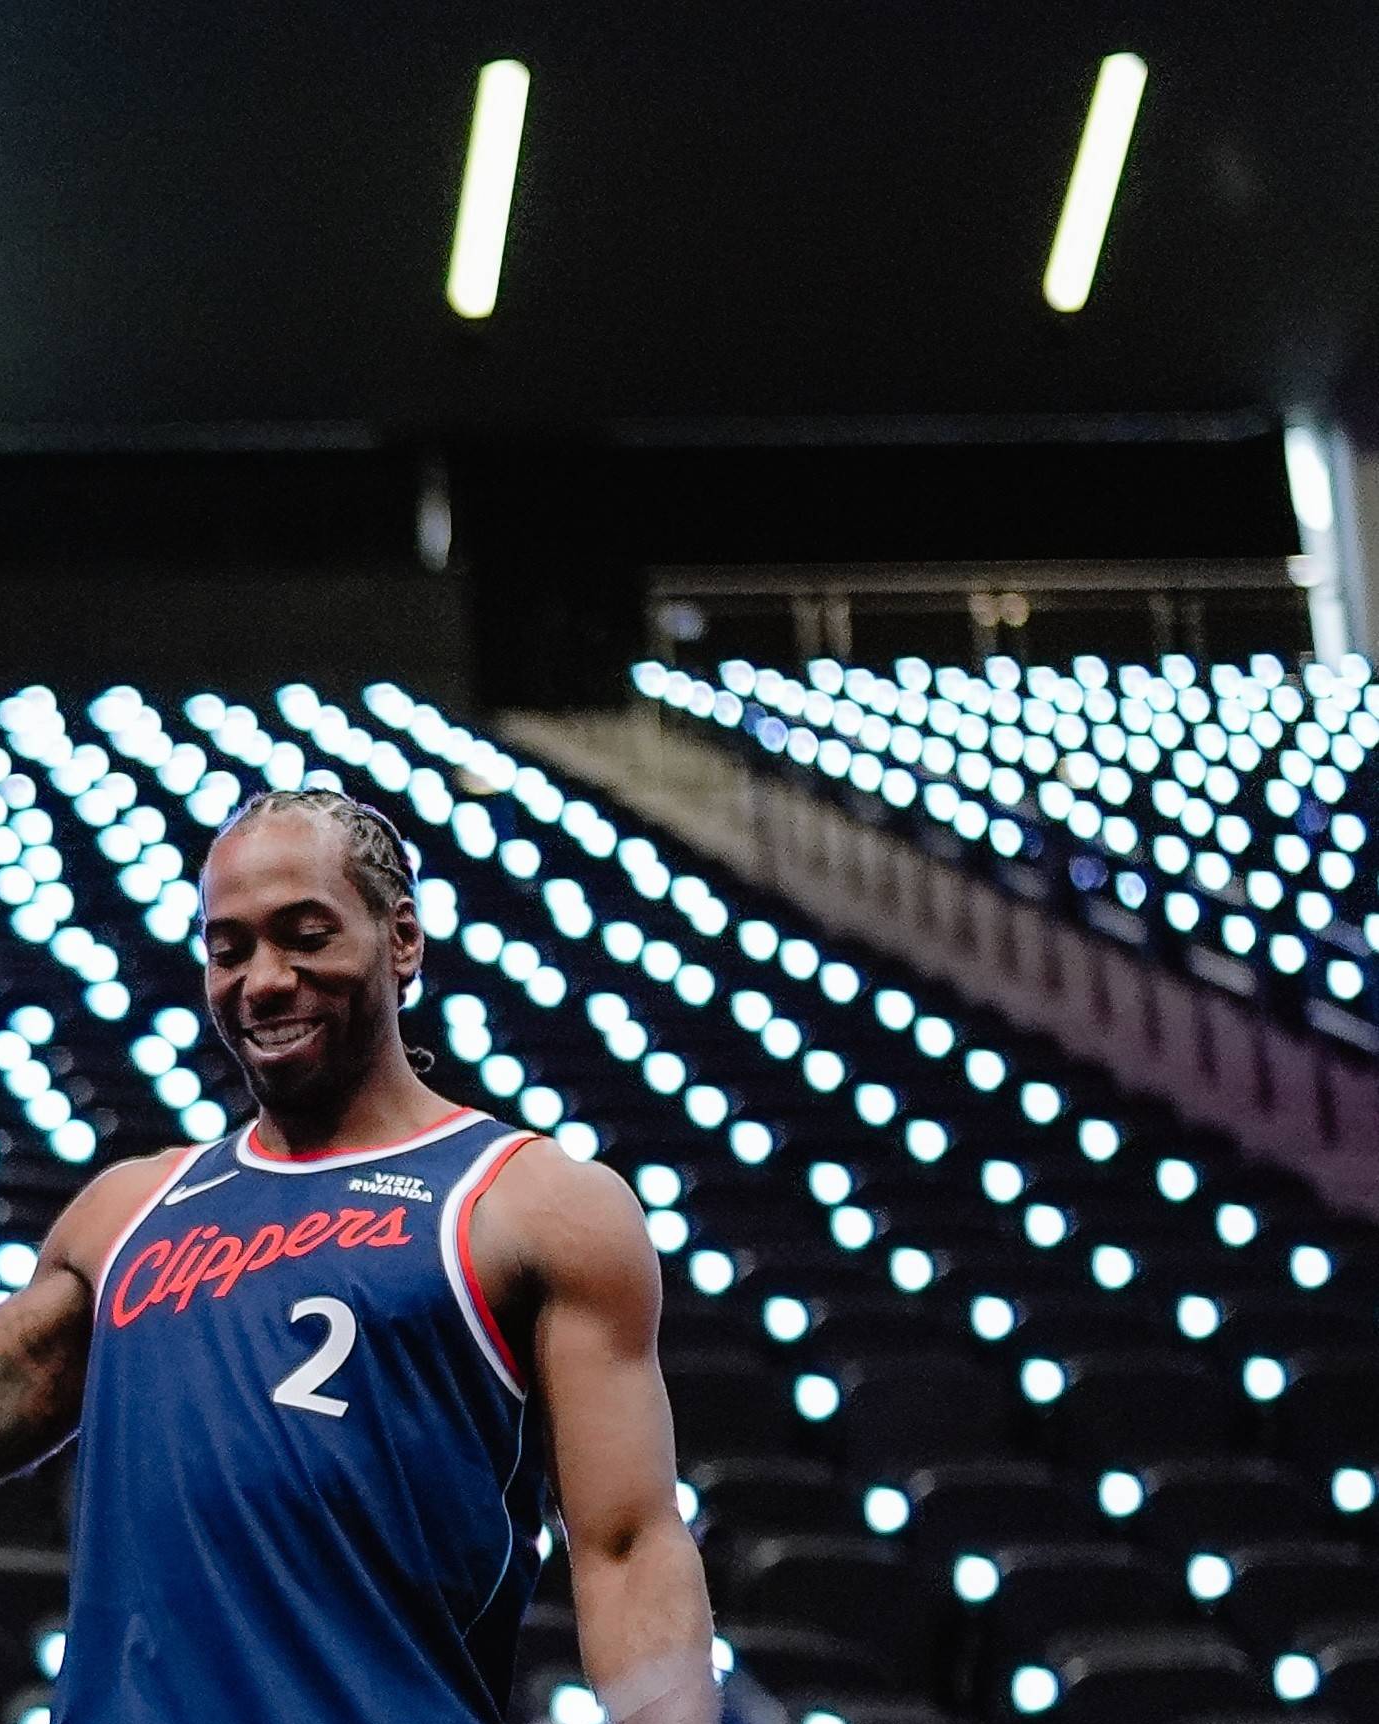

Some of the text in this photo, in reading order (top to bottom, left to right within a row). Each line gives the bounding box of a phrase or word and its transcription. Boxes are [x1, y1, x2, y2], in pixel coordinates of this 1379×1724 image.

[348, 1178, 433, 1203] RWANDA
[374, 1172, 425, 1191] VISIT
[111, 1206, 413, 1328] Clippers
[271, 1296, 357, 1418] 2
